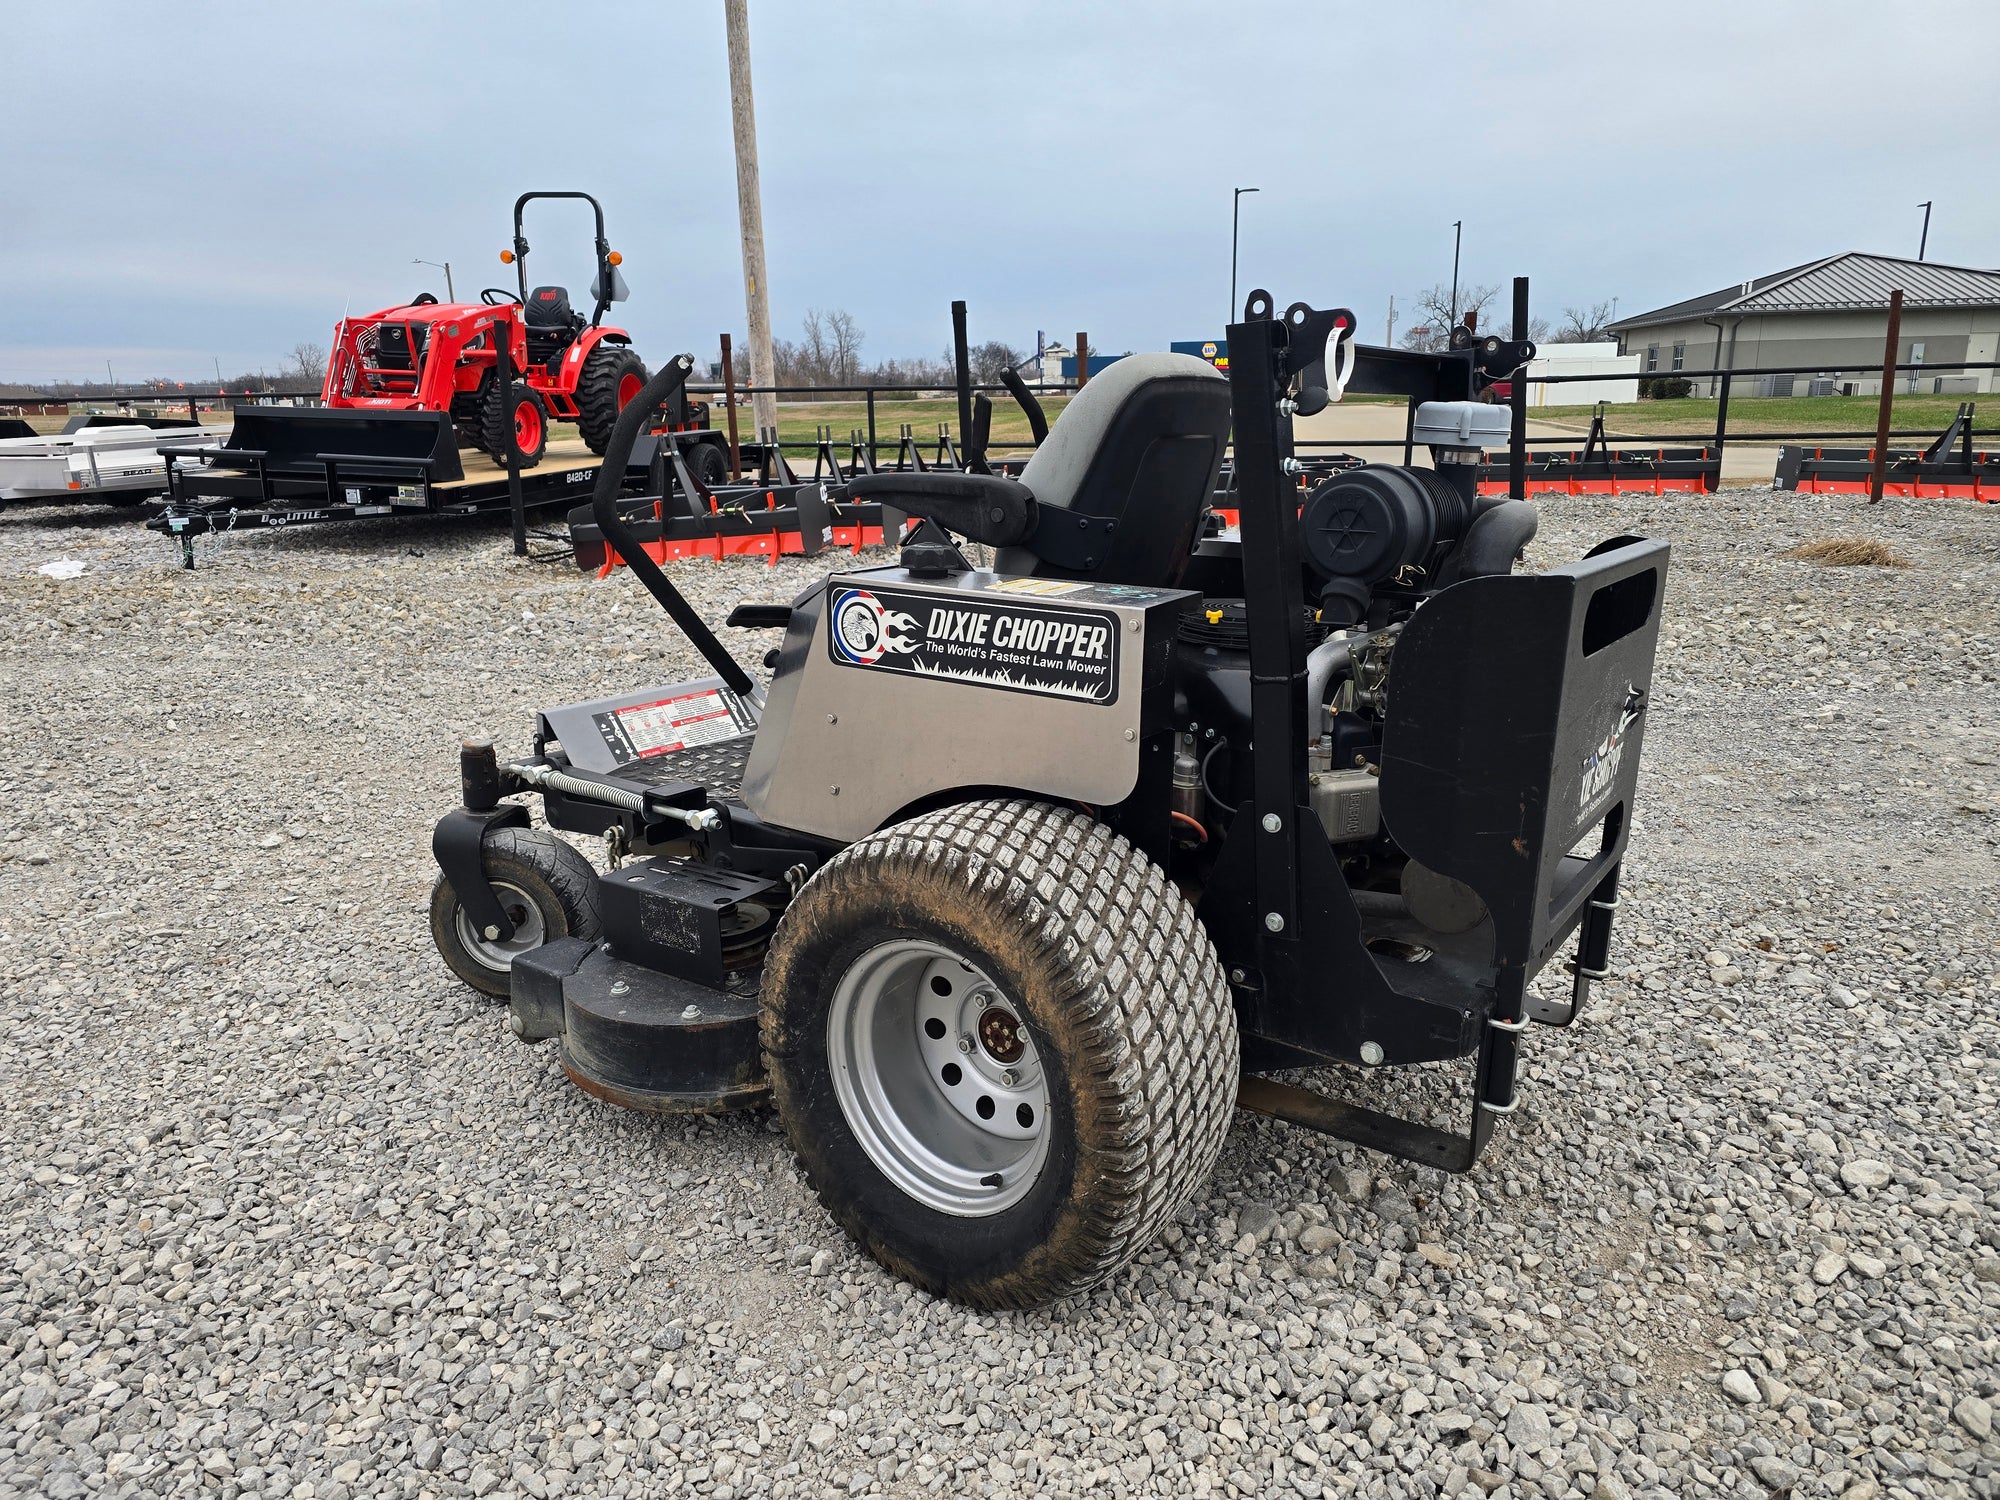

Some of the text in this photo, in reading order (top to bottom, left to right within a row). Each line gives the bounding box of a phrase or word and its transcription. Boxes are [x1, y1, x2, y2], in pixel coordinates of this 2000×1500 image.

[123, 468, 152, 477] BEAR
[926, 608, 991, 645] DIXIE
[992, 616, 1107, 660] CHOPPER
[925, 640, 1107, 675] The World's Fastest Lawn Mower
